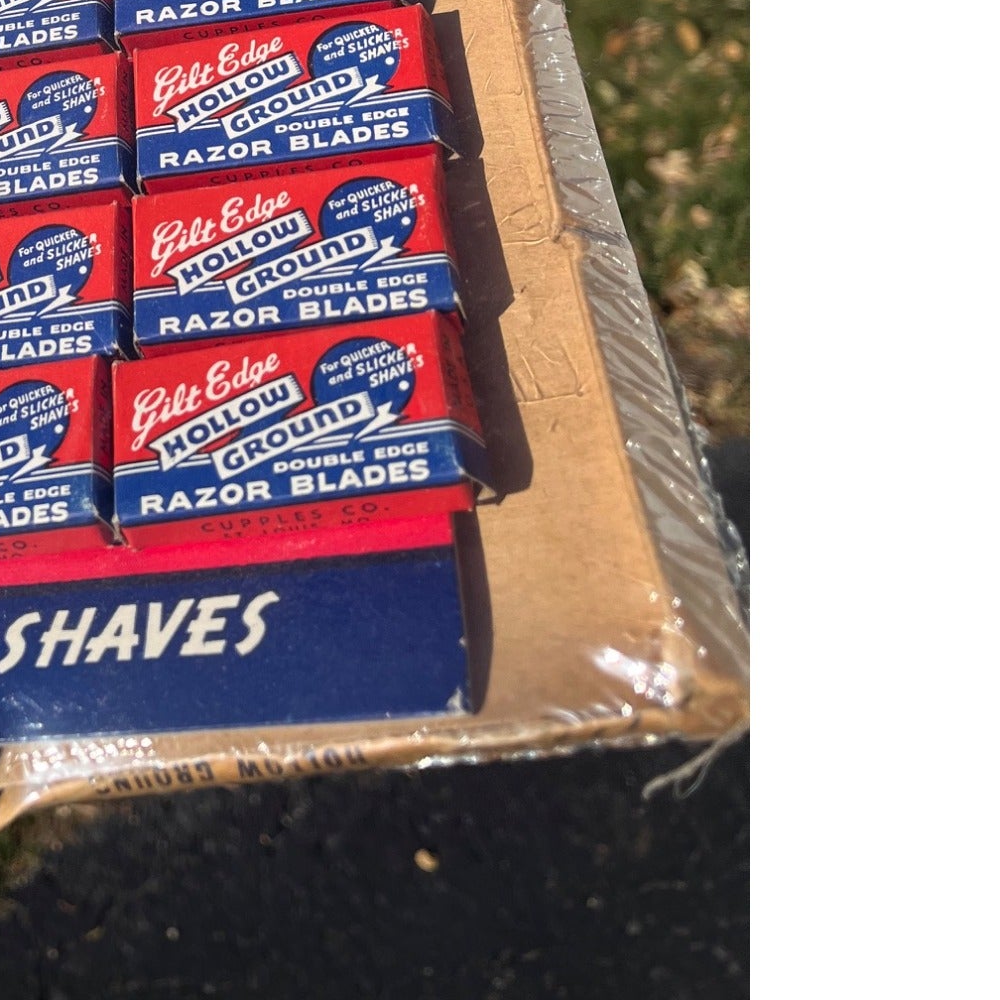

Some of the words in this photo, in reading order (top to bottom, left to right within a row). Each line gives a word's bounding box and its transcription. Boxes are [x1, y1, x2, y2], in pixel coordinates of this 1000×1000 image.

[26, 91, 41, 101] For
[42, 74, 83, 95] QUICKER
[31, 95, 51, 110] and
[53, 75, 102, 103] SLICKER
[62, 85, 107, 112] SHAVES
[59, 153, 101, 168] EDGE
[328, 198, 346, 210] For
[347, 180, 395, 204] QUICKER
[335, 204, 359, 220] and
[361, 182, 419, 212] SLICKER
[374, 193, 426, 223] SHAVES
[150, 216, 217, 278] Gilt
[220, 190, 291, 233] Edge
[180, 218, 299, 284] HOLLOW
[235, 234, 366, 297] GROUND
[282, 279, 369, 300] DOUBLE
[377, 272, 429, 288] EDGE
[159, 306, 281, 336] RAZOR
[299, 288, 429, 321] BLADES
[320, 361, 339, 374] For
[340, 340, 391, 367] QUICKER
[328, 367, 353, 385] and
[355, 342, 417, 376] SLICKER
[369, 355, 425, 388] SHAVES
[131, 383, 202, 452] Gilt
[205, 352, 281, 400] Edge
[162, 383, 290, 458] HOLLOW
[222, 400, 362, 471] GROUND
[273, 450, 365, 474] DOUBLE
[374, 441, 430, 460] EDGE
[140, 480, 272, 516] RAZOR
[291, 459, 430, 497] BLADES
[201, 509, 323, 534] CUPPLES
